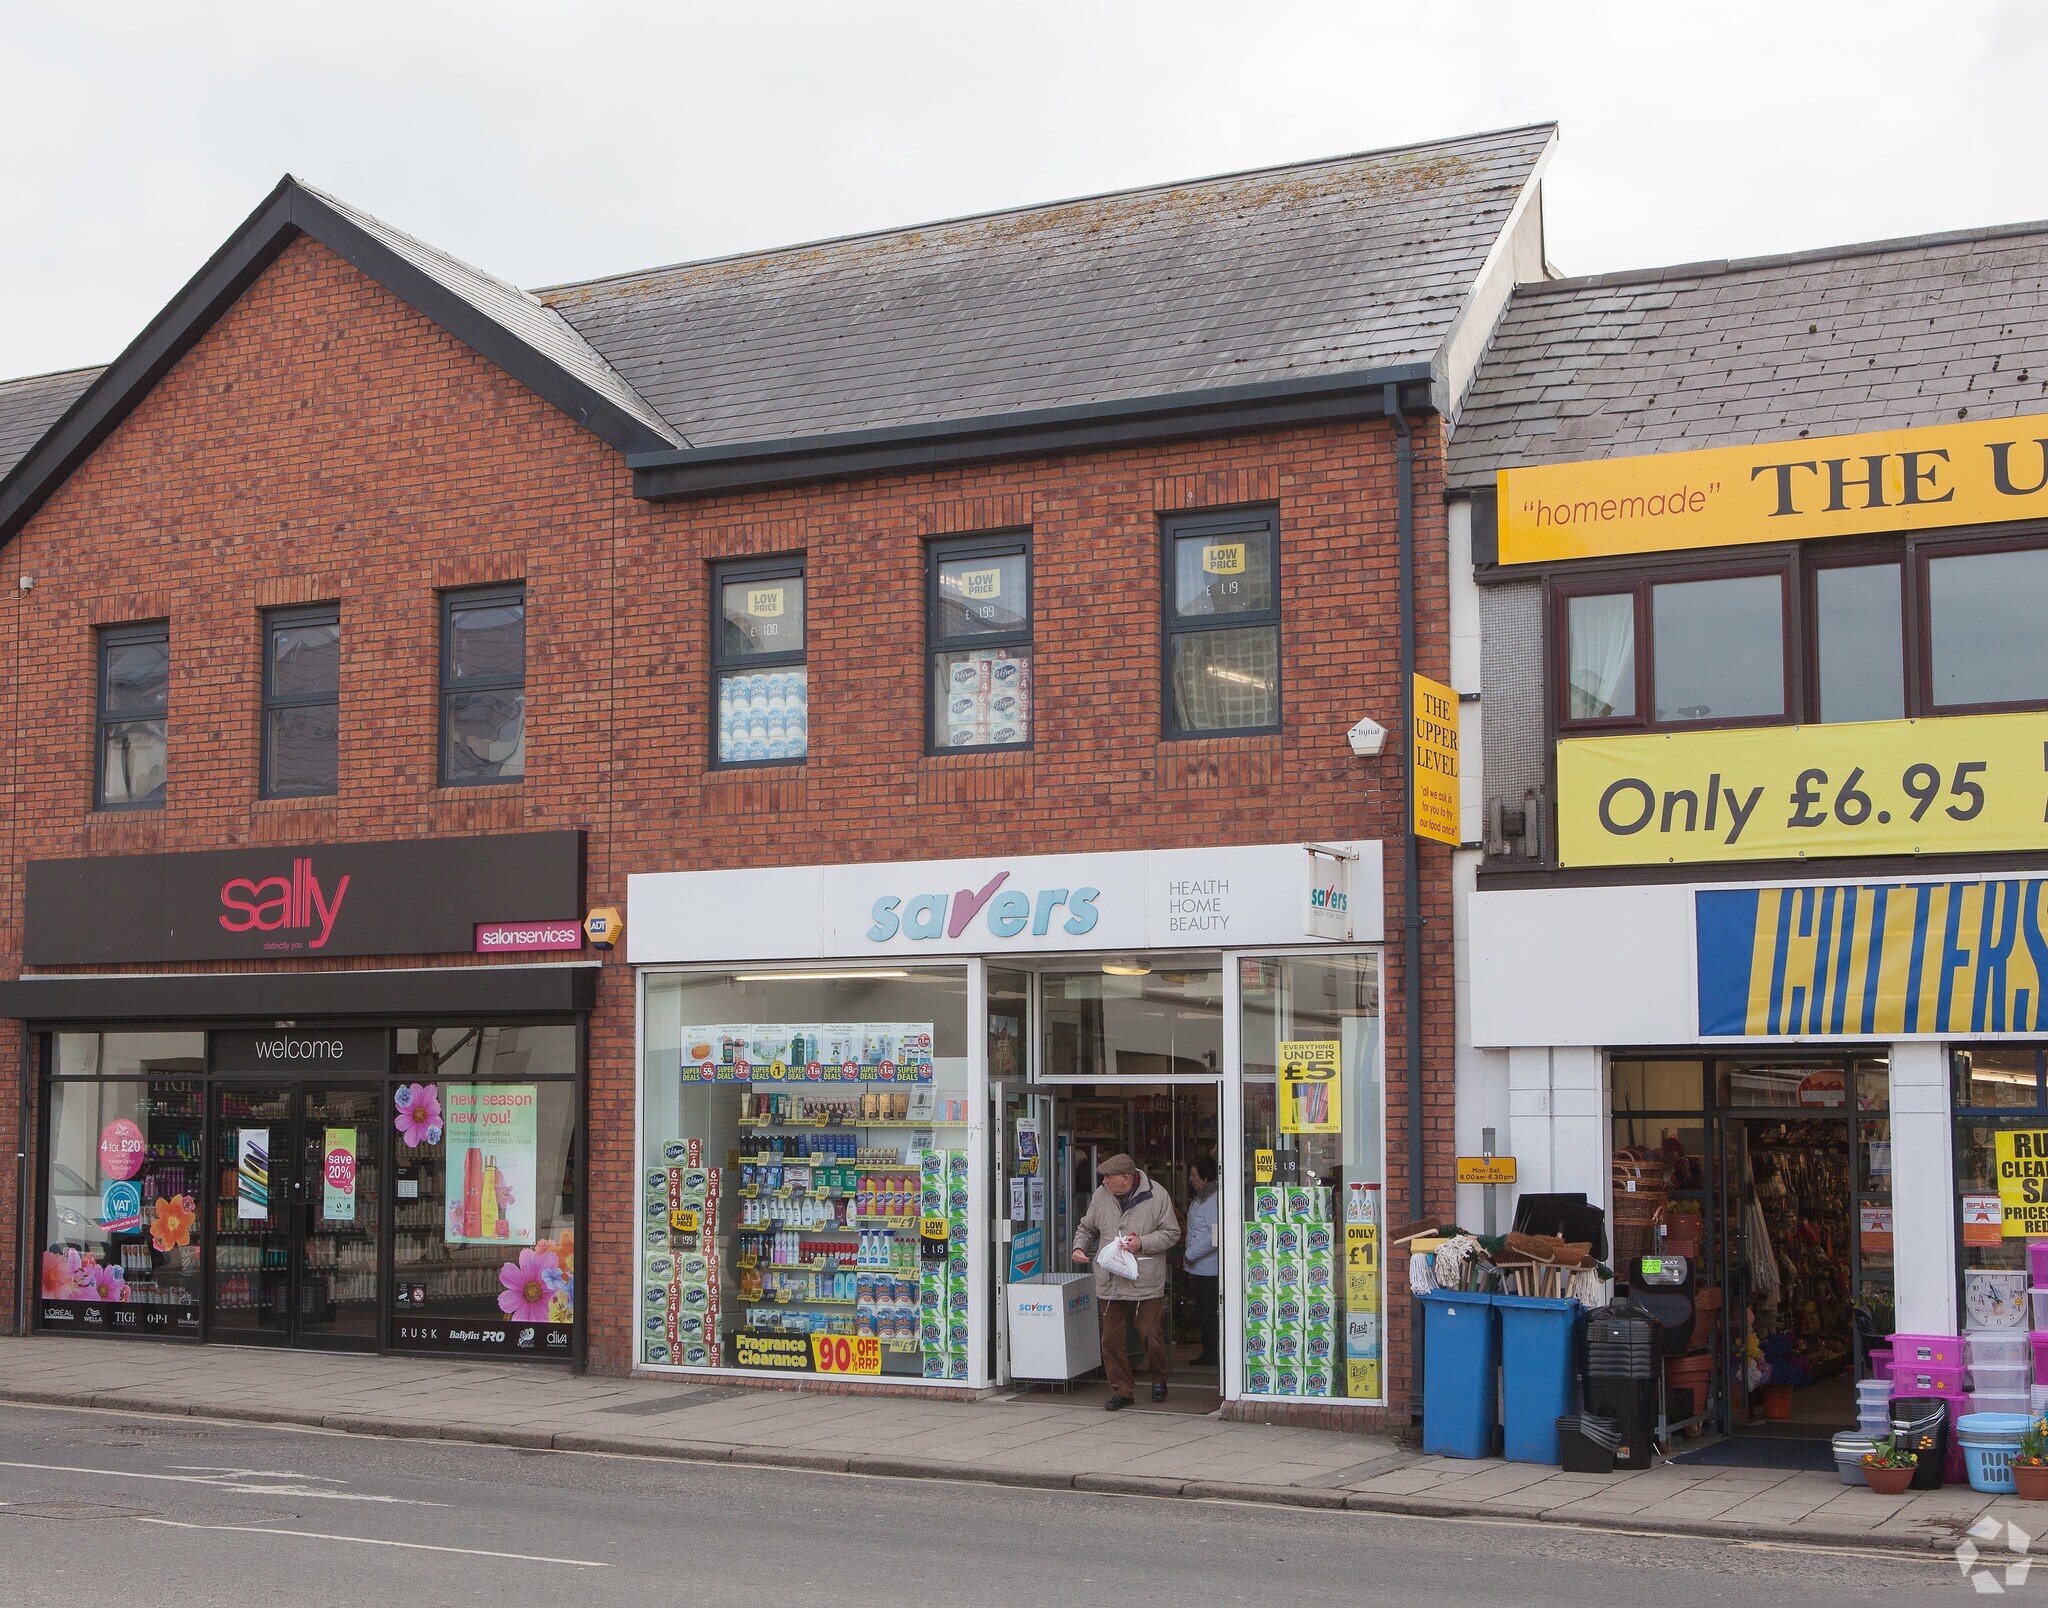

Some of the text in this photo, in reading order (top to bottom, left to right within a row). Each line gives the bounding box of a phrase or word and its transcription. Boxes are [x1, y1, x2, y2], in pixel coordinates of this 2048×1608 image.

[1750, 448, 1956, 518] THE
[1210, 549, 1238, 560] LOW
[1210, 560, 1238, 570] PRICE
[968, 573, 994, 587] LOW
[968, 584, 994, 595] PRICE
[754, 592, 778, 605] LOW
[754, 602, 778, 613] PRICE
[1423, 692, 1451, 721] THE
[1415, 718, 1459, 752] UPPER
[1417, 745, 1458, 778] LEVEL
[1430, 790, 1438, 800] we
[1438, 792, 1448, 803] ask
[1447, 793, 1453, 804] is
[1598, 772, 1766, 845] Only
[1786, 761, 1988, 829] £6.95
[1421, 800, 1454, 822] for you to try
[1419, 818, 1429, 829] our
[1429, 818, 1442, 832] food
[1169, 879, 1229, 896] HEALTH
[218, 857, 351, 949] sally
[1311, 884, 1348, 912] savers
[865, 869, 1100, 942] savers
[1169, 898, 1222, 914] HOME
[590, 920, 607, 933] ADT
[1169, 915, 1230, 931] BEAUTY
[481, 926, 576, 946] salonservices
[263, 942, 303, 952] distinctly you
[255, 1035, 344, 1059] welcome
[1283, 1043, 1335, 1051] EVERYTHING
[1284, 1050, 1335, 1060] UNDER
[1284, 1060, 1336, 1080] £5
[449, 1094, 533, 1106] new season
[449, 1109, 511, 1127] new you!
[101, 1139, 108, 1152] 4
[109, 1140, 120, 1153] for
[666, 1146, 685, 1158] Velvet
[691, 1141, 697, 1150] 6
[328, 1154, 353, 1165] save
[690, 1158, 697, 1168] 4
[1256, 1155, 1273, 1164] LOW
[328, 1165, 352, 1180] 20%
[710, 1169, 717, 1178] 6
[1256, 1164, 1273, 1173] PRICE
[710, 1188, 717, 1197] 4
[112, 1200, 131, 1211] VAT
[1288, 1197, 1310, 1212] Plenty
[115, 1210, 127, 1219] free
[676, 1213, 694, 1222] LOW
[676, 1220, 693, 1228] PRICE
[925, 1221, 943, 1229] LOW
[515, 1228, 531, 1240] sally
[925, 1228, 943, 1236] PRICE
[1347, 1228, 1375, 1239] ONLY
[1307, 1233, 1330, 1248] Plenty
[1348, 1242, 1374, 1266] £1
[1247, 1268, 1269, 1283] Plenty
[1018, 1301, 1053, 1312] savers
[1308, 1305, 1330, 1320] Plenty
[1349, 1321, 1368, 1336] Flash
[449, 1330, 506, 1343] BaByliss PRO
[736, 1334, 807, 1353] Fragrance
[857, 1338, 879, 1357] OFF
[1246, 1339, 1267, 1353] Plenty
[738, 1350, 808, 1368] Clearance
[858, 1357, 879, 1370] RRP
